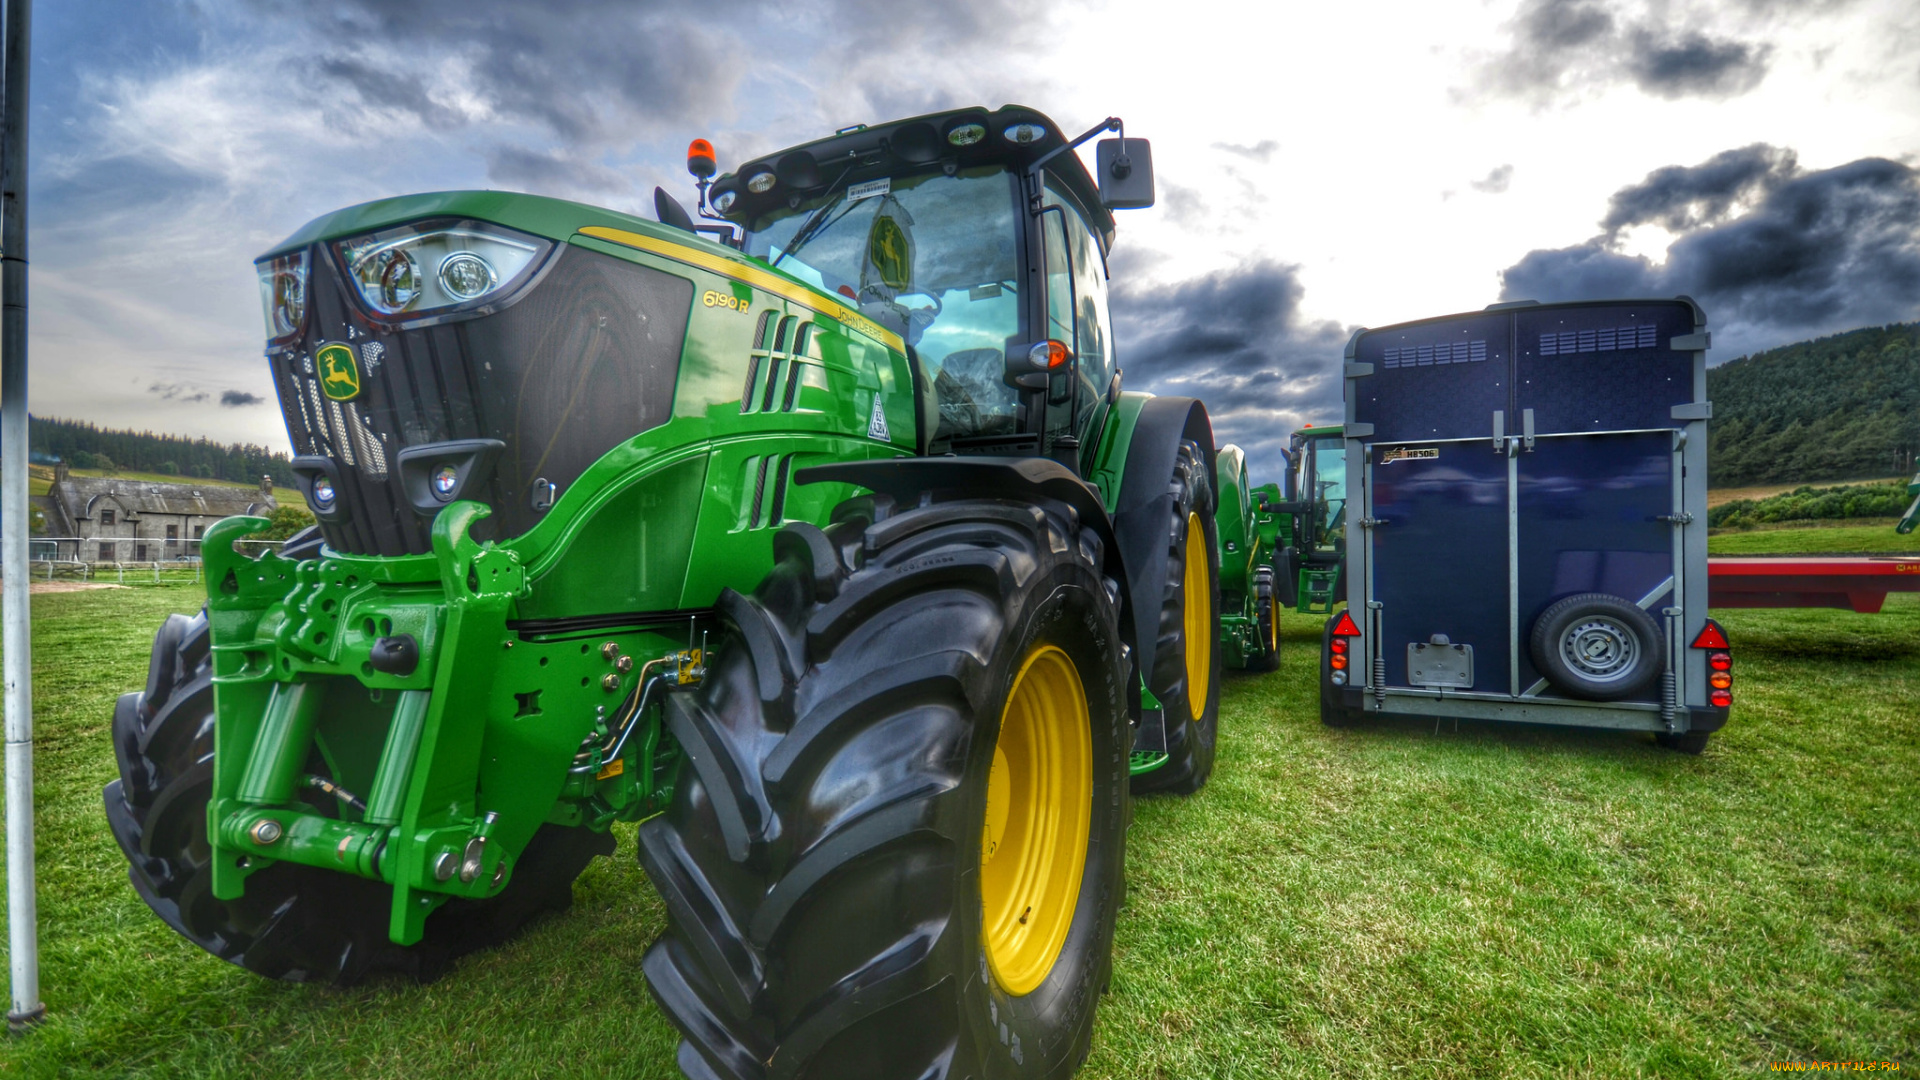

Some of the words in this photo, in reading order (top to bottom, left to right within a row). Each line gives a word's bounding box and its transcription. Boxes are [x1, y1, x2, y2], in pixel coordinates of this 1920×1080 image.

[703, 290, 738, 309] 6190
[738, 299, 750, 315] R
[837, 307, 859, 329] JOHN
[859, 317, 883, 341] DEERE
[1407, 450, 1435, 458] HB506
